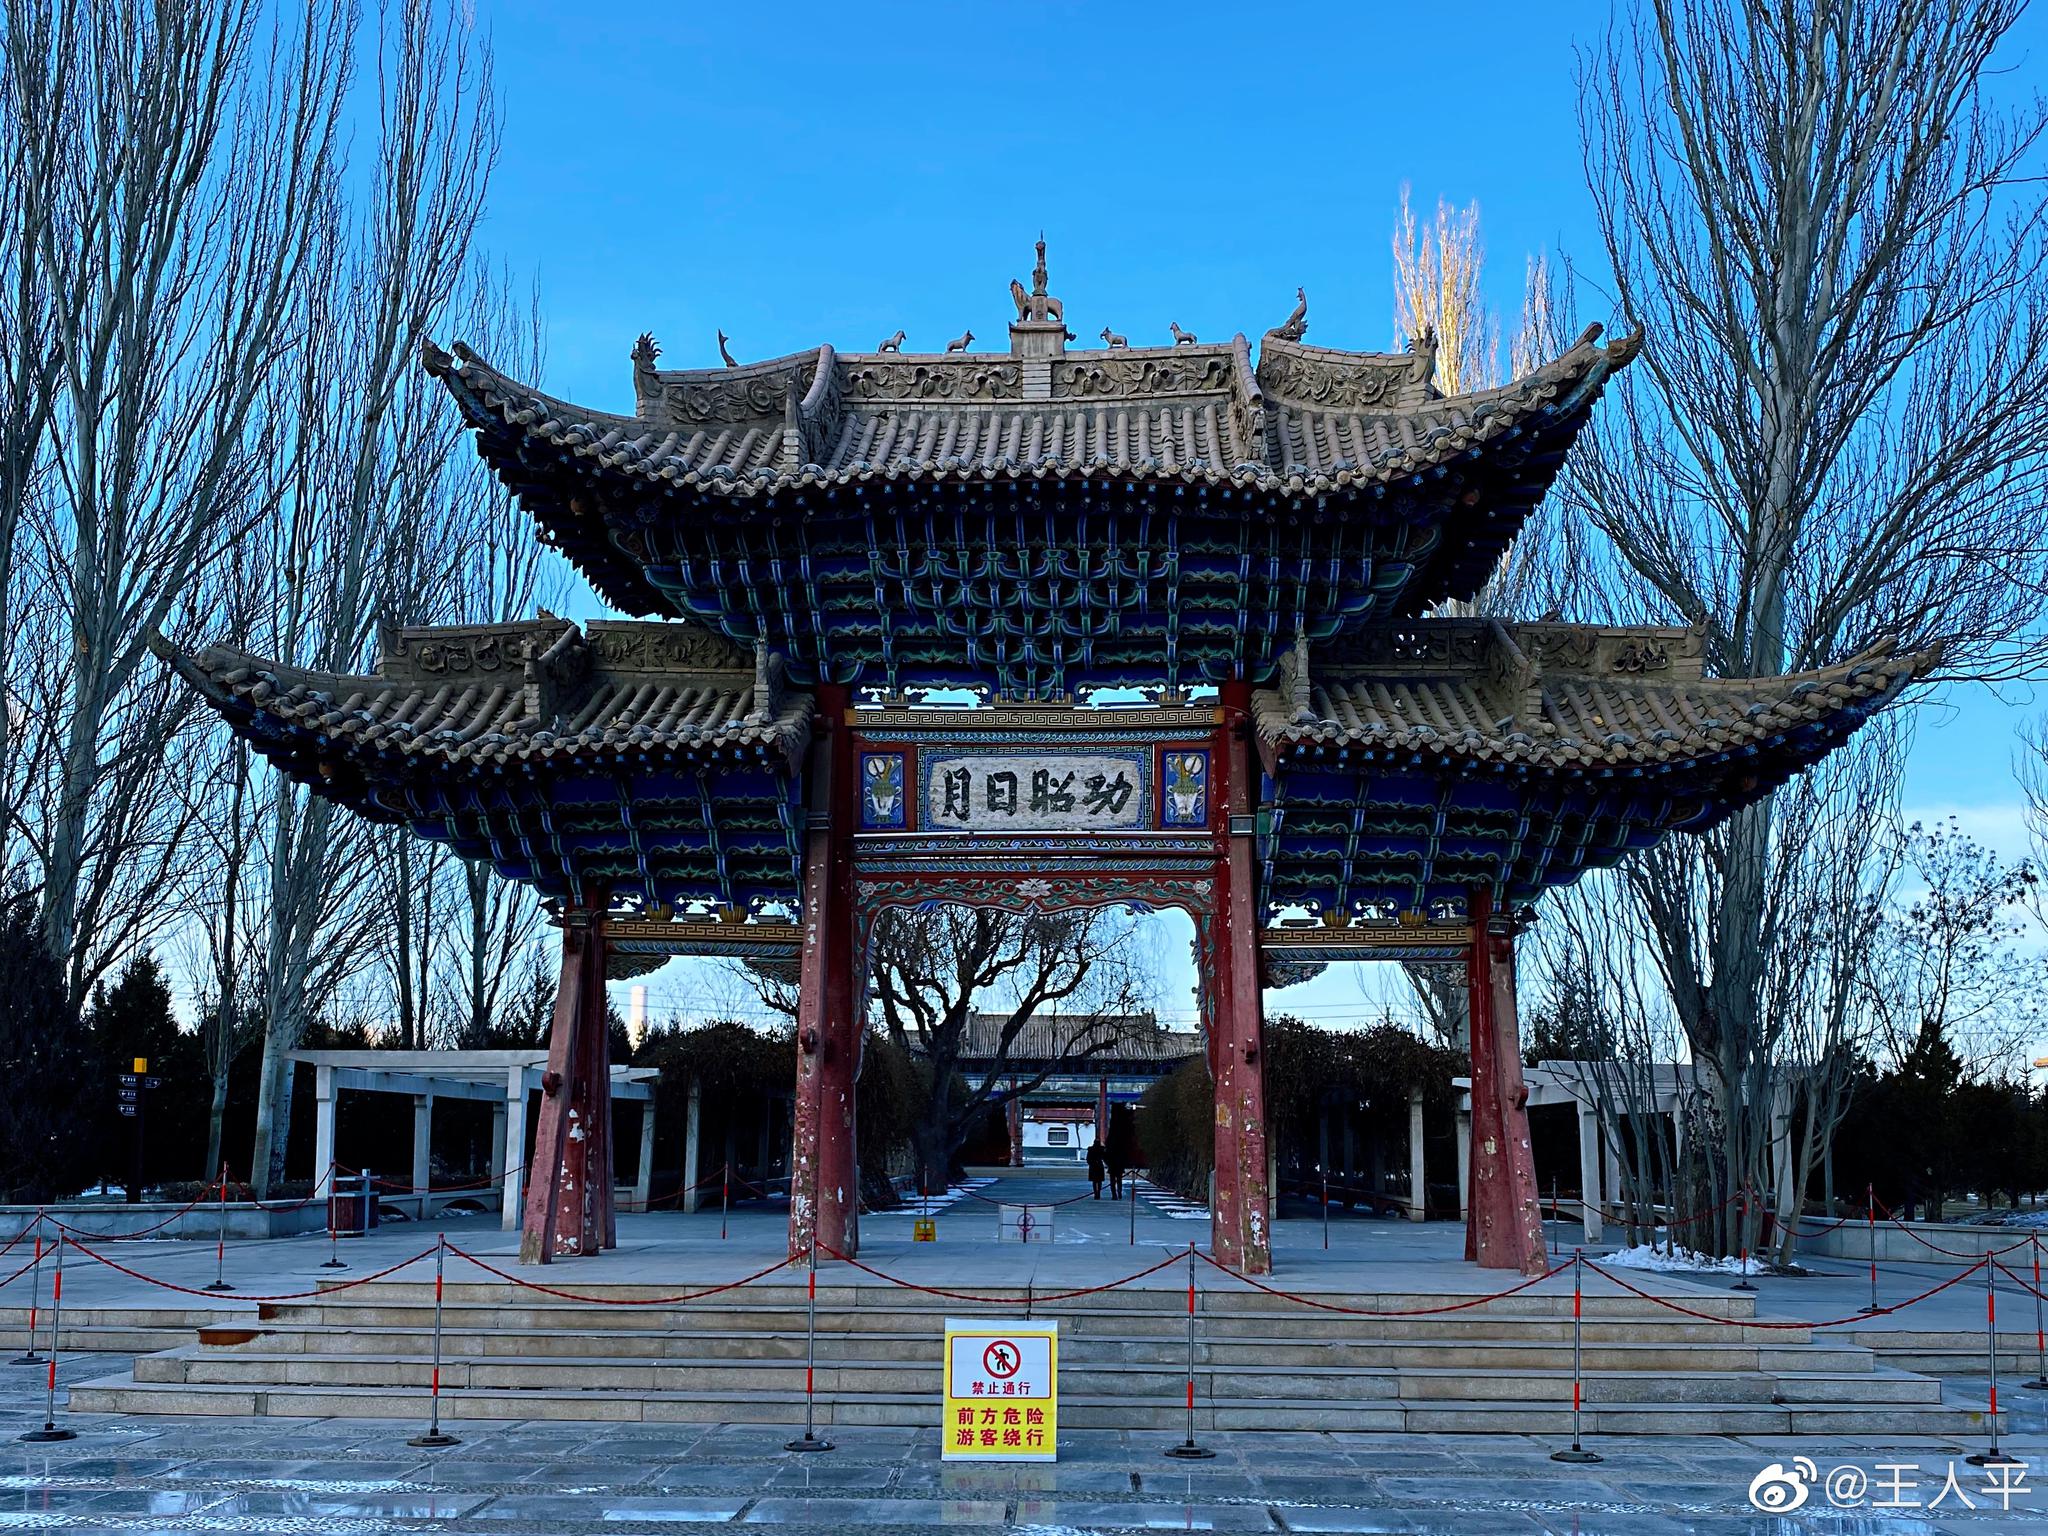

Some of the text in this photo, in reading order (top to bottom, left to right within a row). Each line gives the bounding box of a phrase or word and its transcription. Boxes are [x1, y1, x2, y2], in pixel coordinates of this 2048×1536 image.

[971, 1381, 1031, 1395] 禁止通行
[957, 1407, 1044, 1425] 前方危险
[956, 1428, 1045, 1446] 游客绕行
